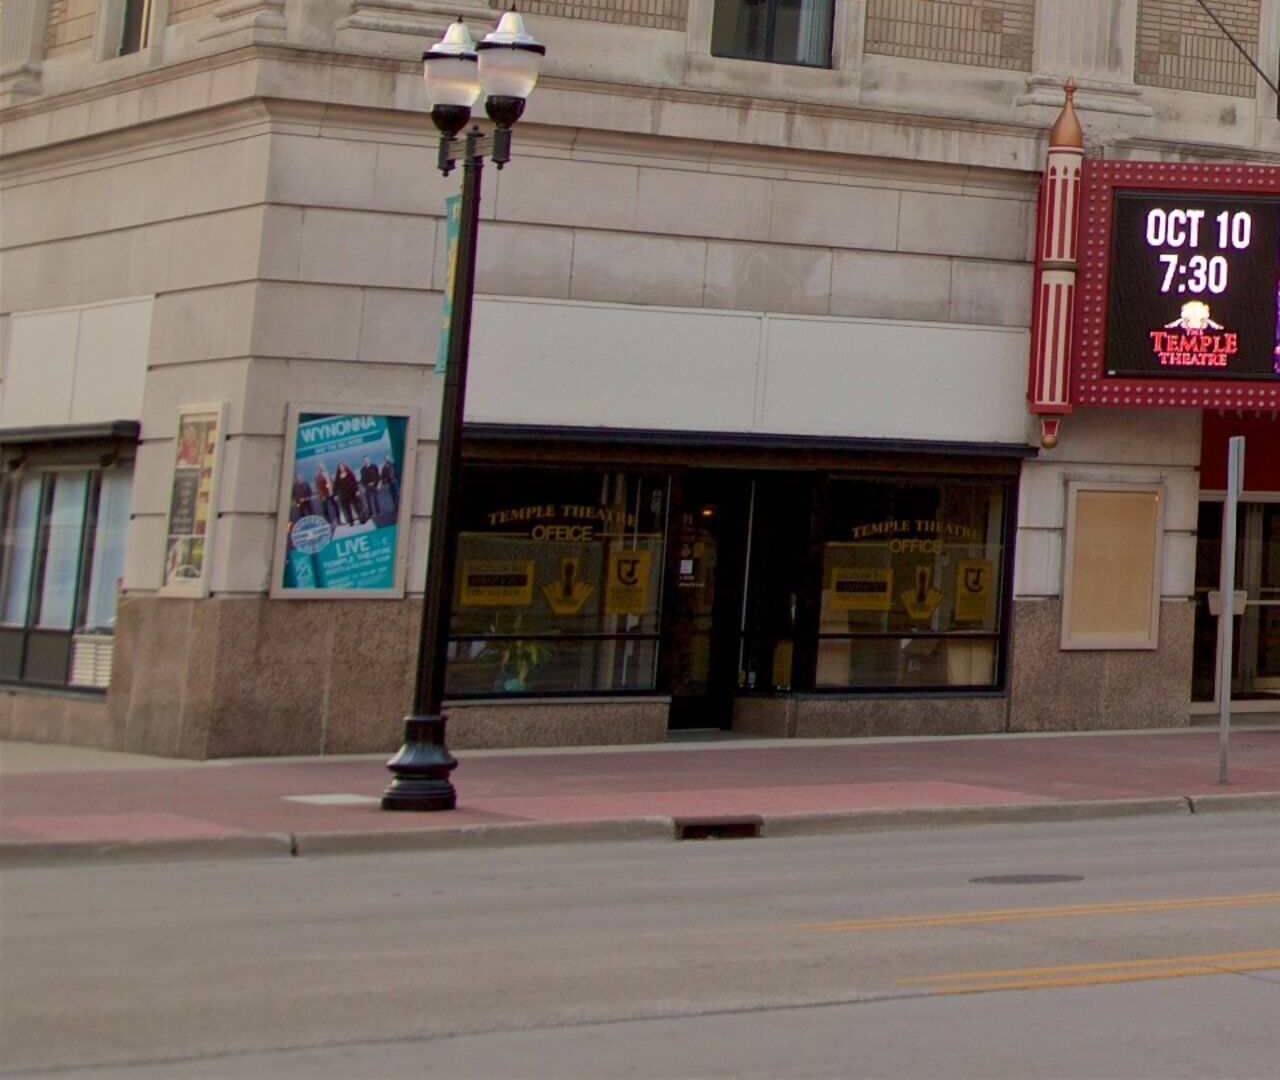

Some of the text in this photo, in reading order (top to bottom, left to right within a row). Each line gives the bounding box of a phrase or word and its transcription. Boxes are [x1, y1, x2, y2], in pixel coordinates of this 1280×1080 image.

[1146, 208, 1252, 250] OCT 10
[1159, 255, 1229, 294] 7:30
[1150, 331, 1238, 354] TEMPLE
[1158, 352, 1228, 366] THEATRE
[300, 416, 377, 443] WYNONNA
[487, 505, 637, 527] TEMPLE THEATRE
[851, 520, 910, 539] TEMPLE
[336, 536, 369, 557] LIVE
[889, 539, 943, 553] OFFICE
